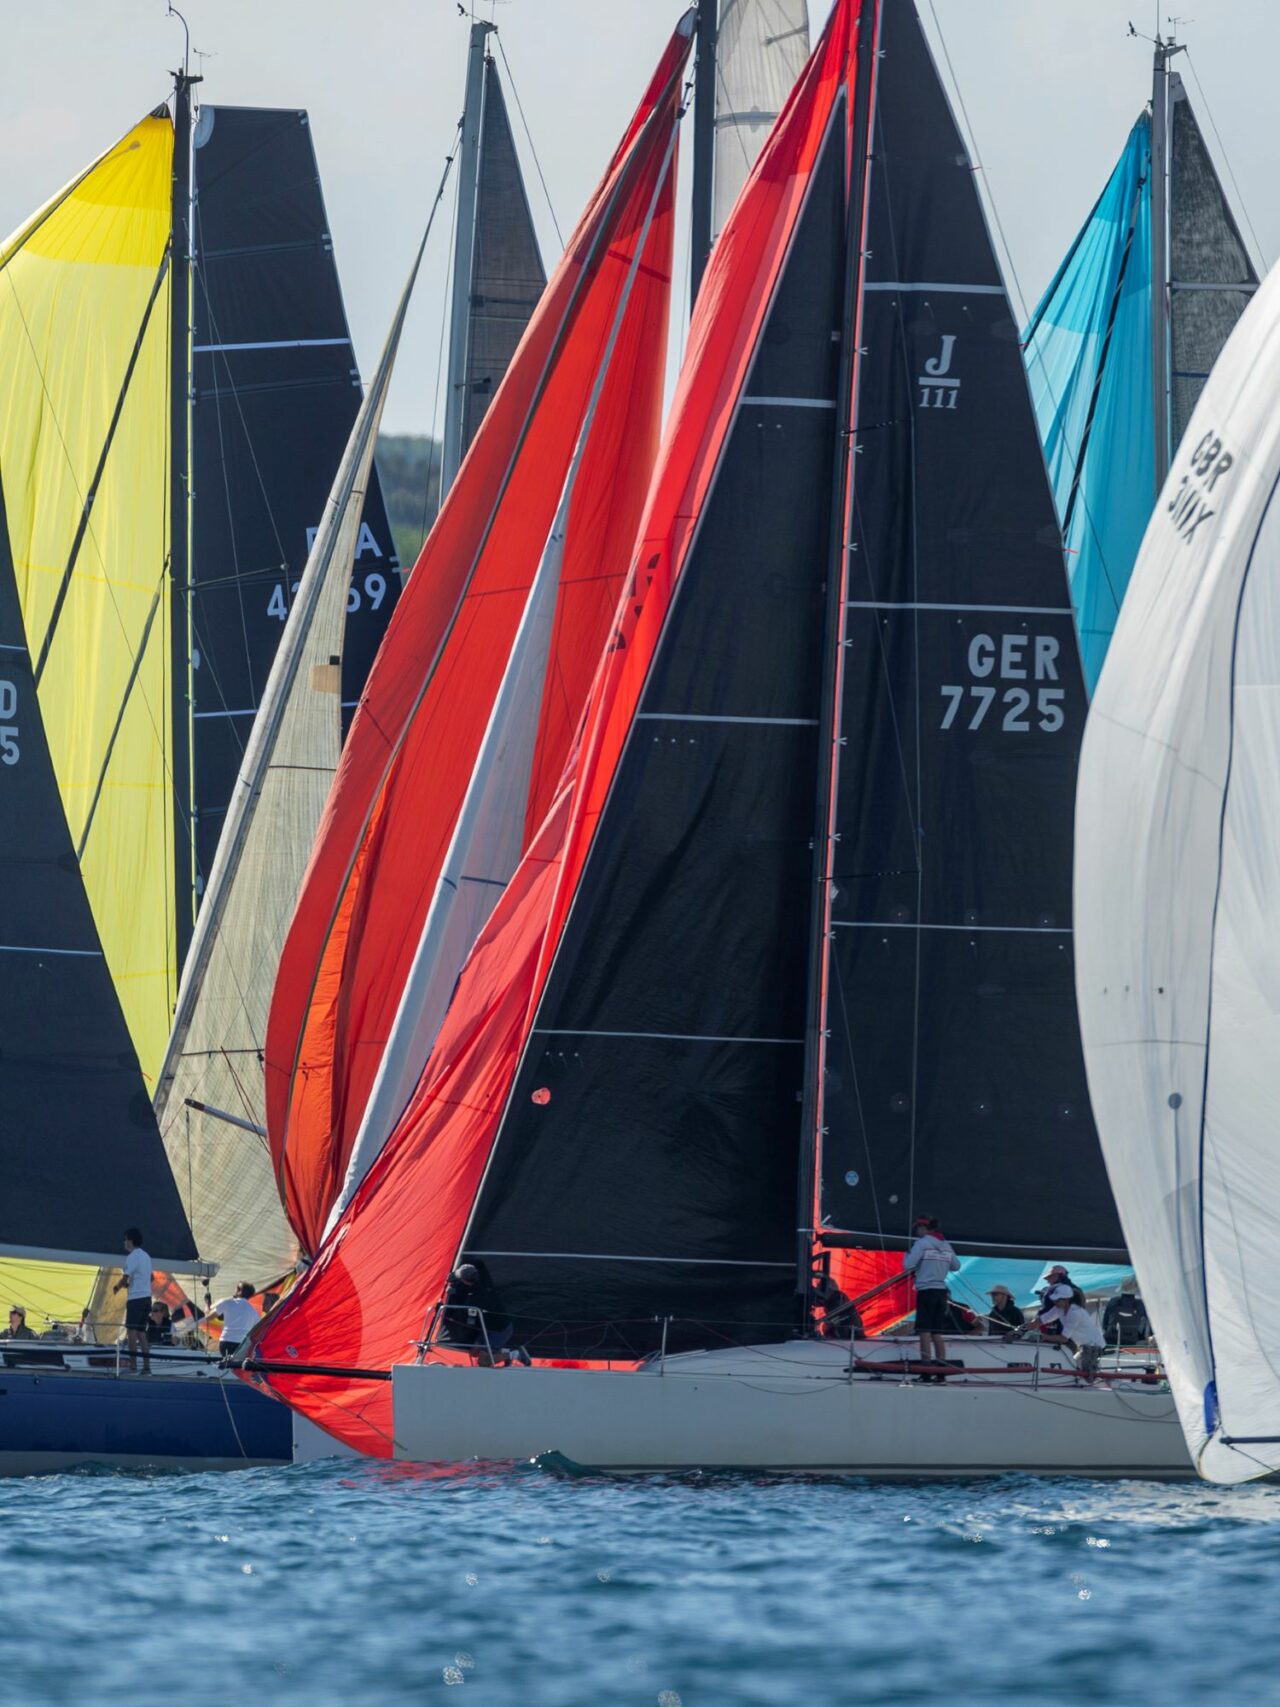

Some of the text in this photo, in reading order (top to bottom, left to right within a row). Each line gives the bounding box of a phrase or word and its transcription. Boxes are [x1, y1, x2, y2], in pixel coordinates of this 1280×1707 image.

[924, 334, 957, 376] J
[918, 387, 958, 409] 111
[1190, 429, 1234, 494] GBR
[967, 633, 1060, 680] GER
[940, 685, 1065, 732] 7725
